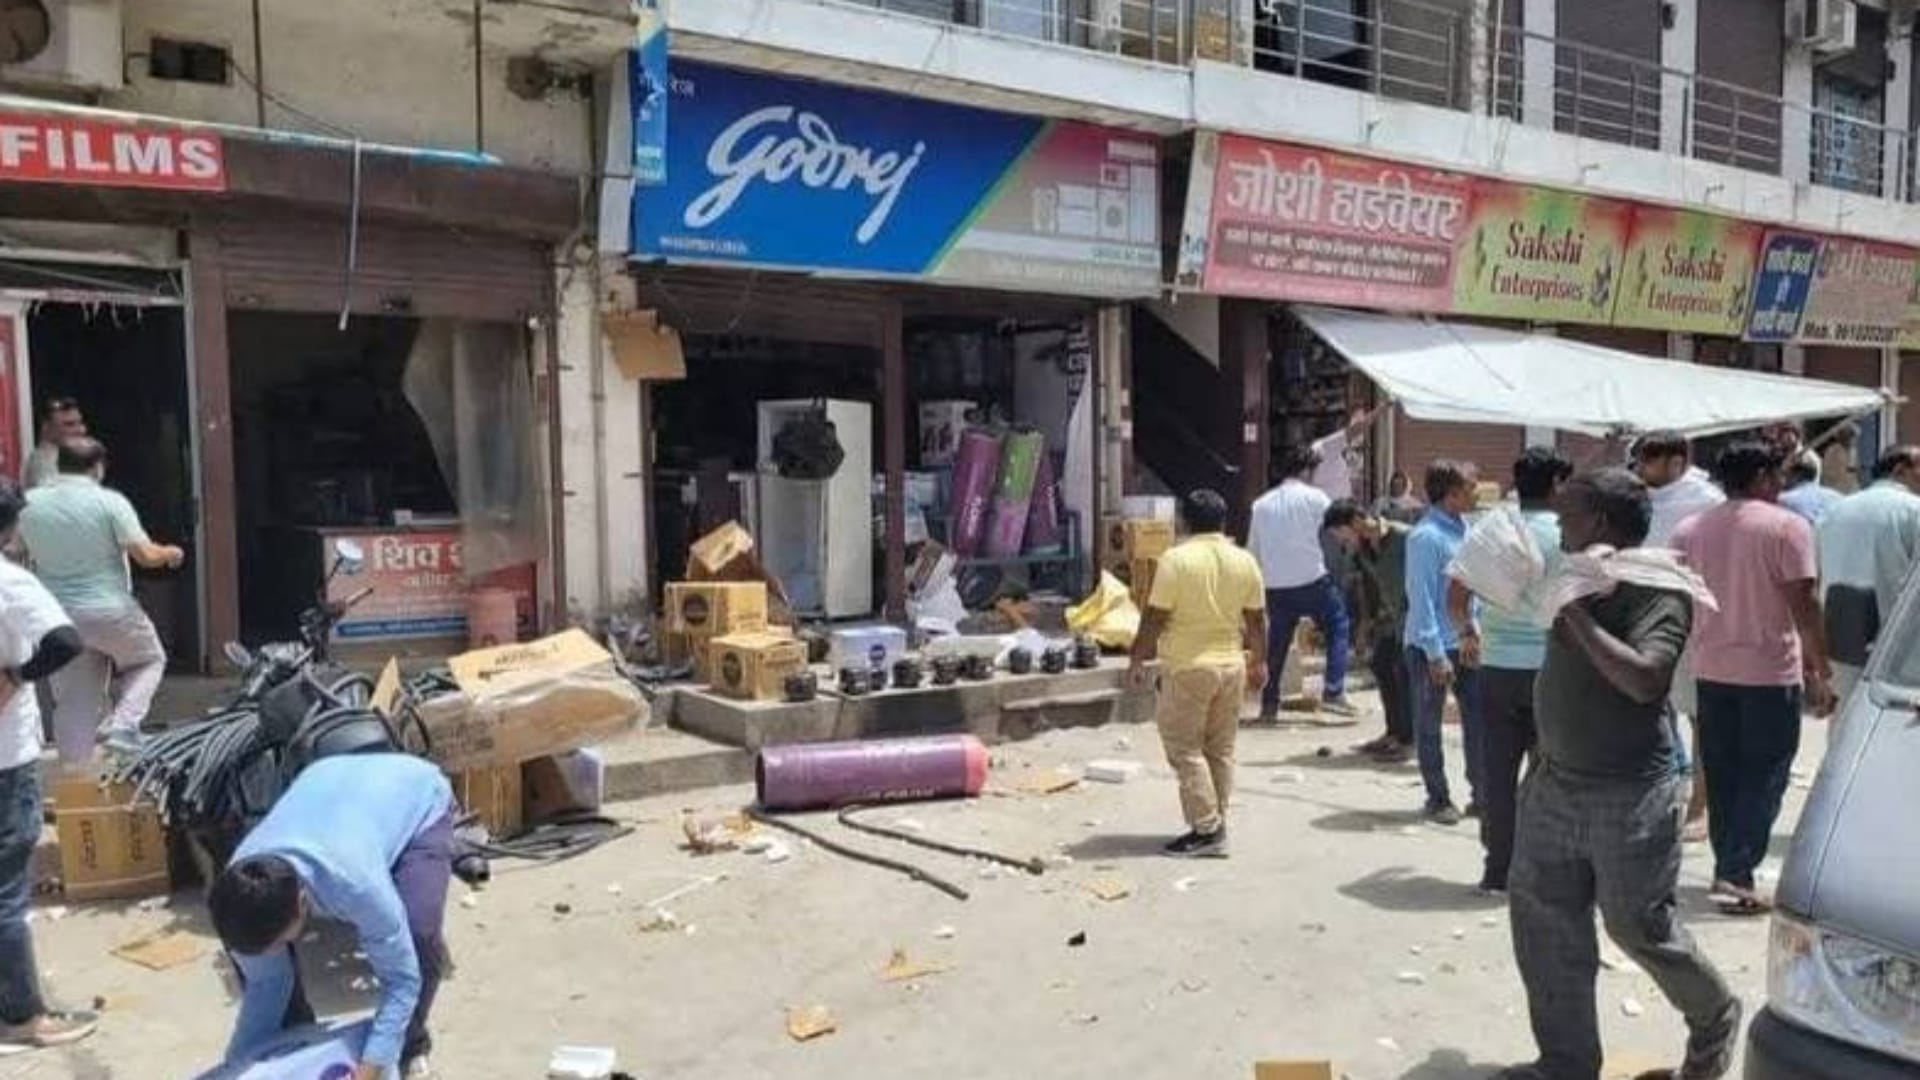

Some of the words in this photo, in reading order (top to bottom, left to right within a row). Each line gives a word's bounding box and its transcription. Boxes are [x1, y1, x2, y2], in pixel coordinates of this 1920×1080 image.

[0, 125, 219, 178] FILMS
[684, 106, 926, 245] Godrej
[1226, 149, 1323, 222] जोशी
[1507, 219, 1585, 266] Sakshi
[1661, 243, 1727, 283] Sakshi
[1491, 264, 1584, 302] Enterprises
[1647, 281, 1723, 317] Enterprises
[371, 534, 442, 571] शिव
